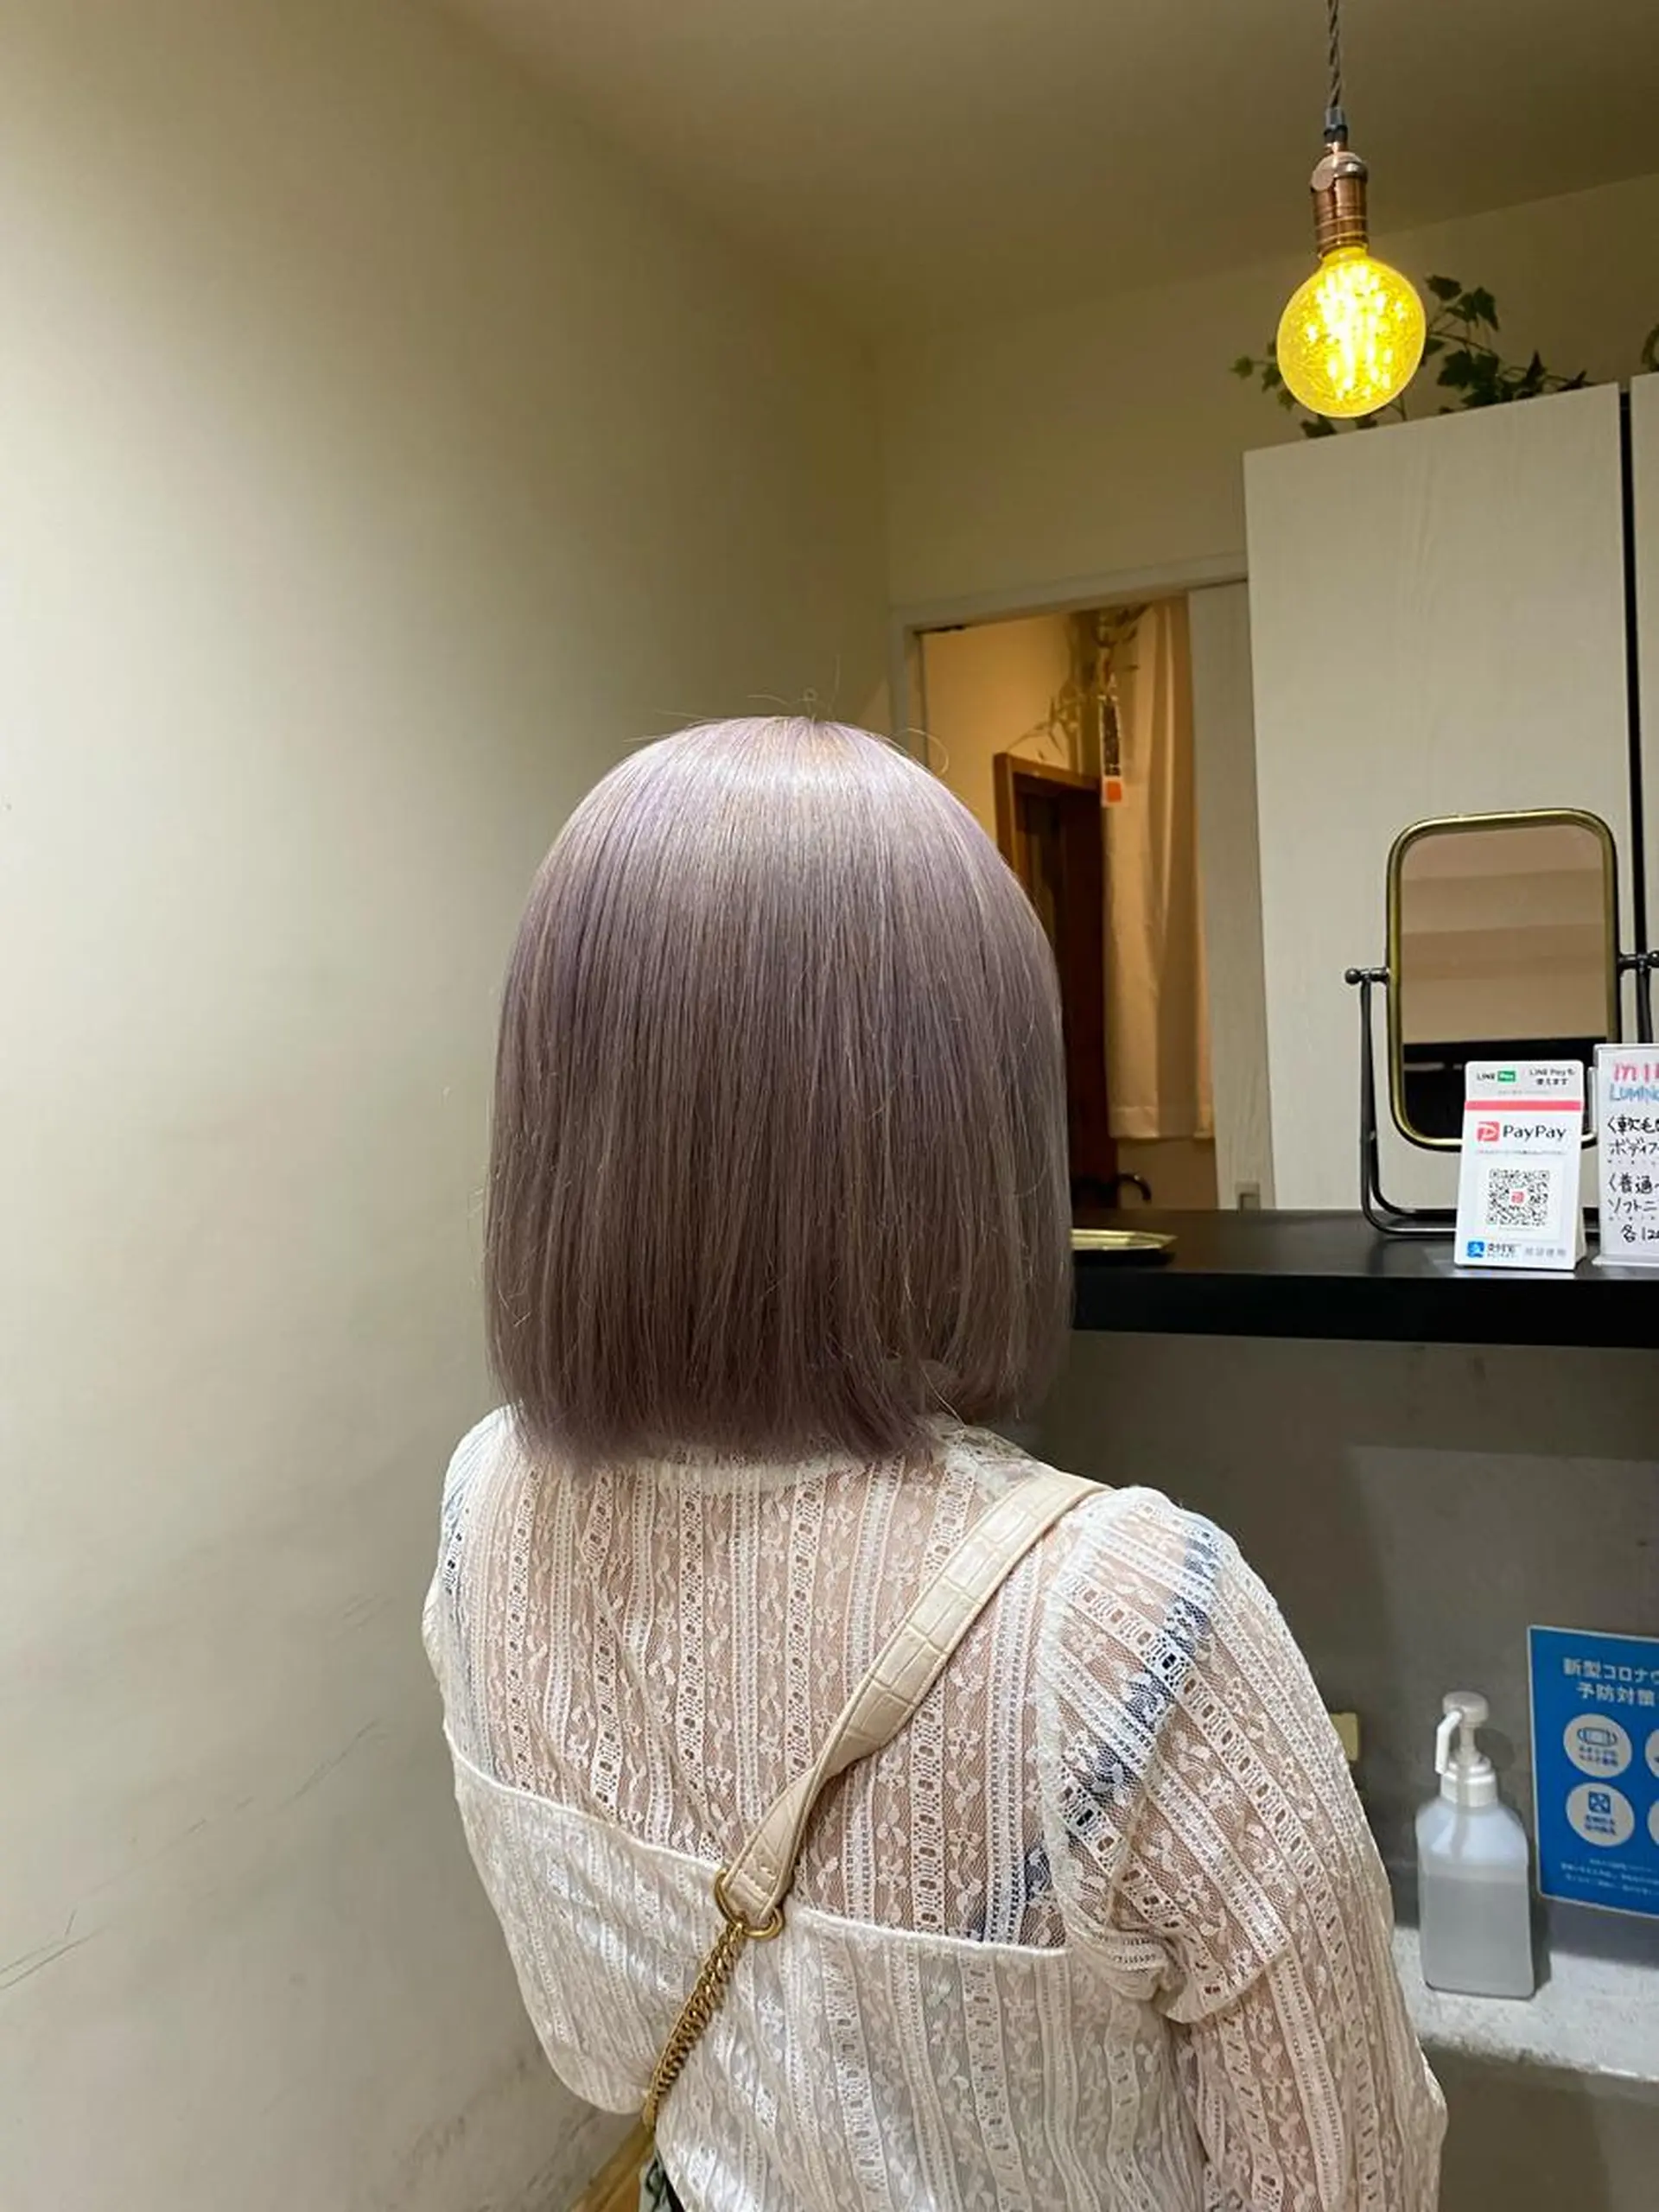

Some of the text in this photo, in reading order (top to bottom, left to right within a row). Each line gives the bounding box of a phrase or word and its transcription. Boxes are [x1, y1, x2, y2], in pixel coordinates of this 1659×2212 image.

[1477, 1072, 1496, 1081] LINE
[1529, 1068, 1548, 1077] LINE
[1503, 1124, 1567, 1142] PayPay
